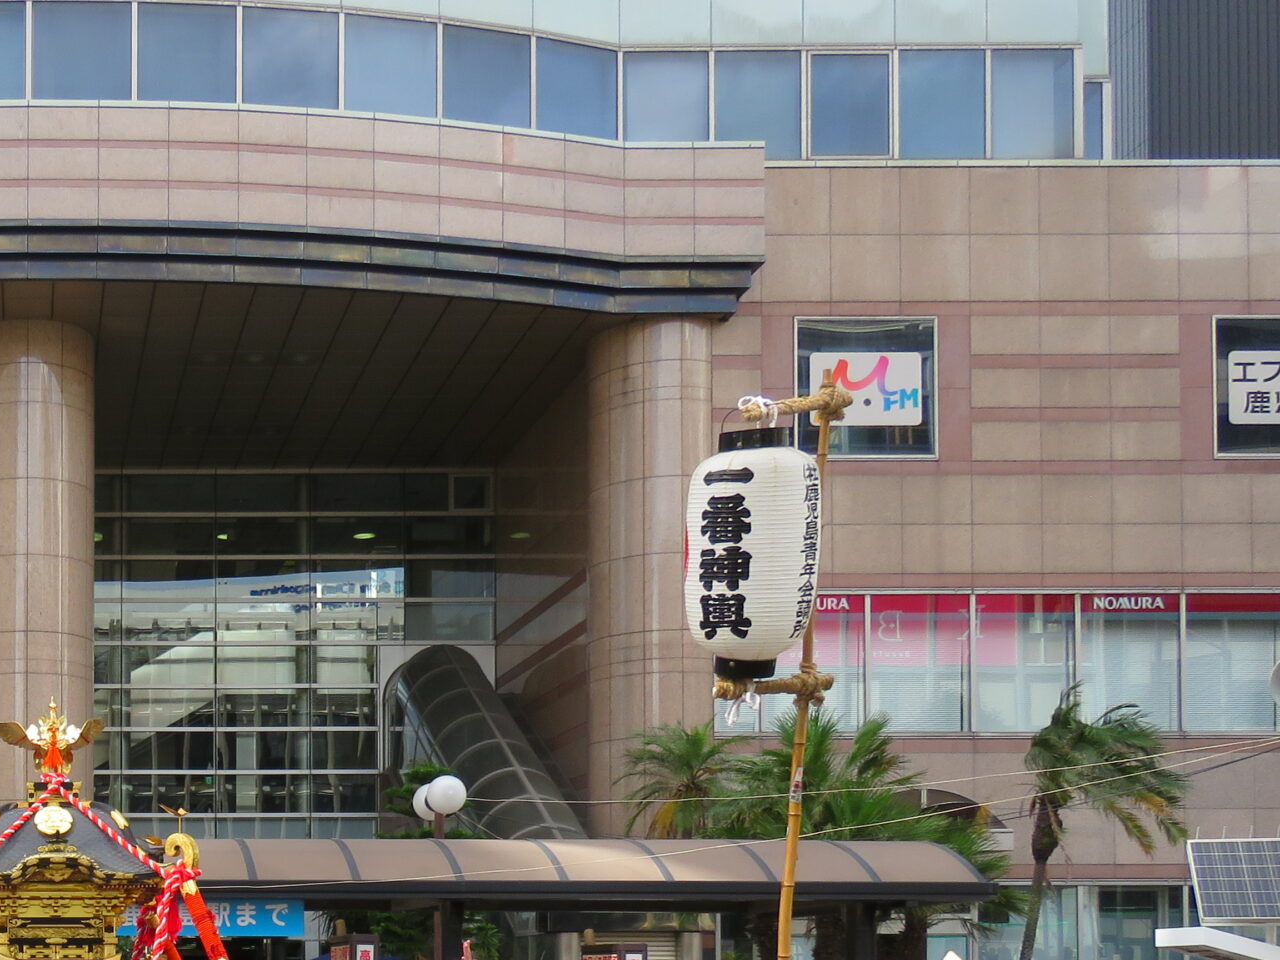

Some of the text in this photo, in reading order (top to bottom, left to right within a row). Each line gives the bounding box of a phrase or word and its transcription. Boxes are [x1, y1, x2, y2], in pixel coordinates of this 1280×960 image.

[883, 388, 919, 412] FM
[1243, 390, 1280, 413] 鹿
[699, 467, 754, 641] 一番神輿
[816, 597, 851, 611] URA
[1093, 597, 1165, 610] NOMURA
